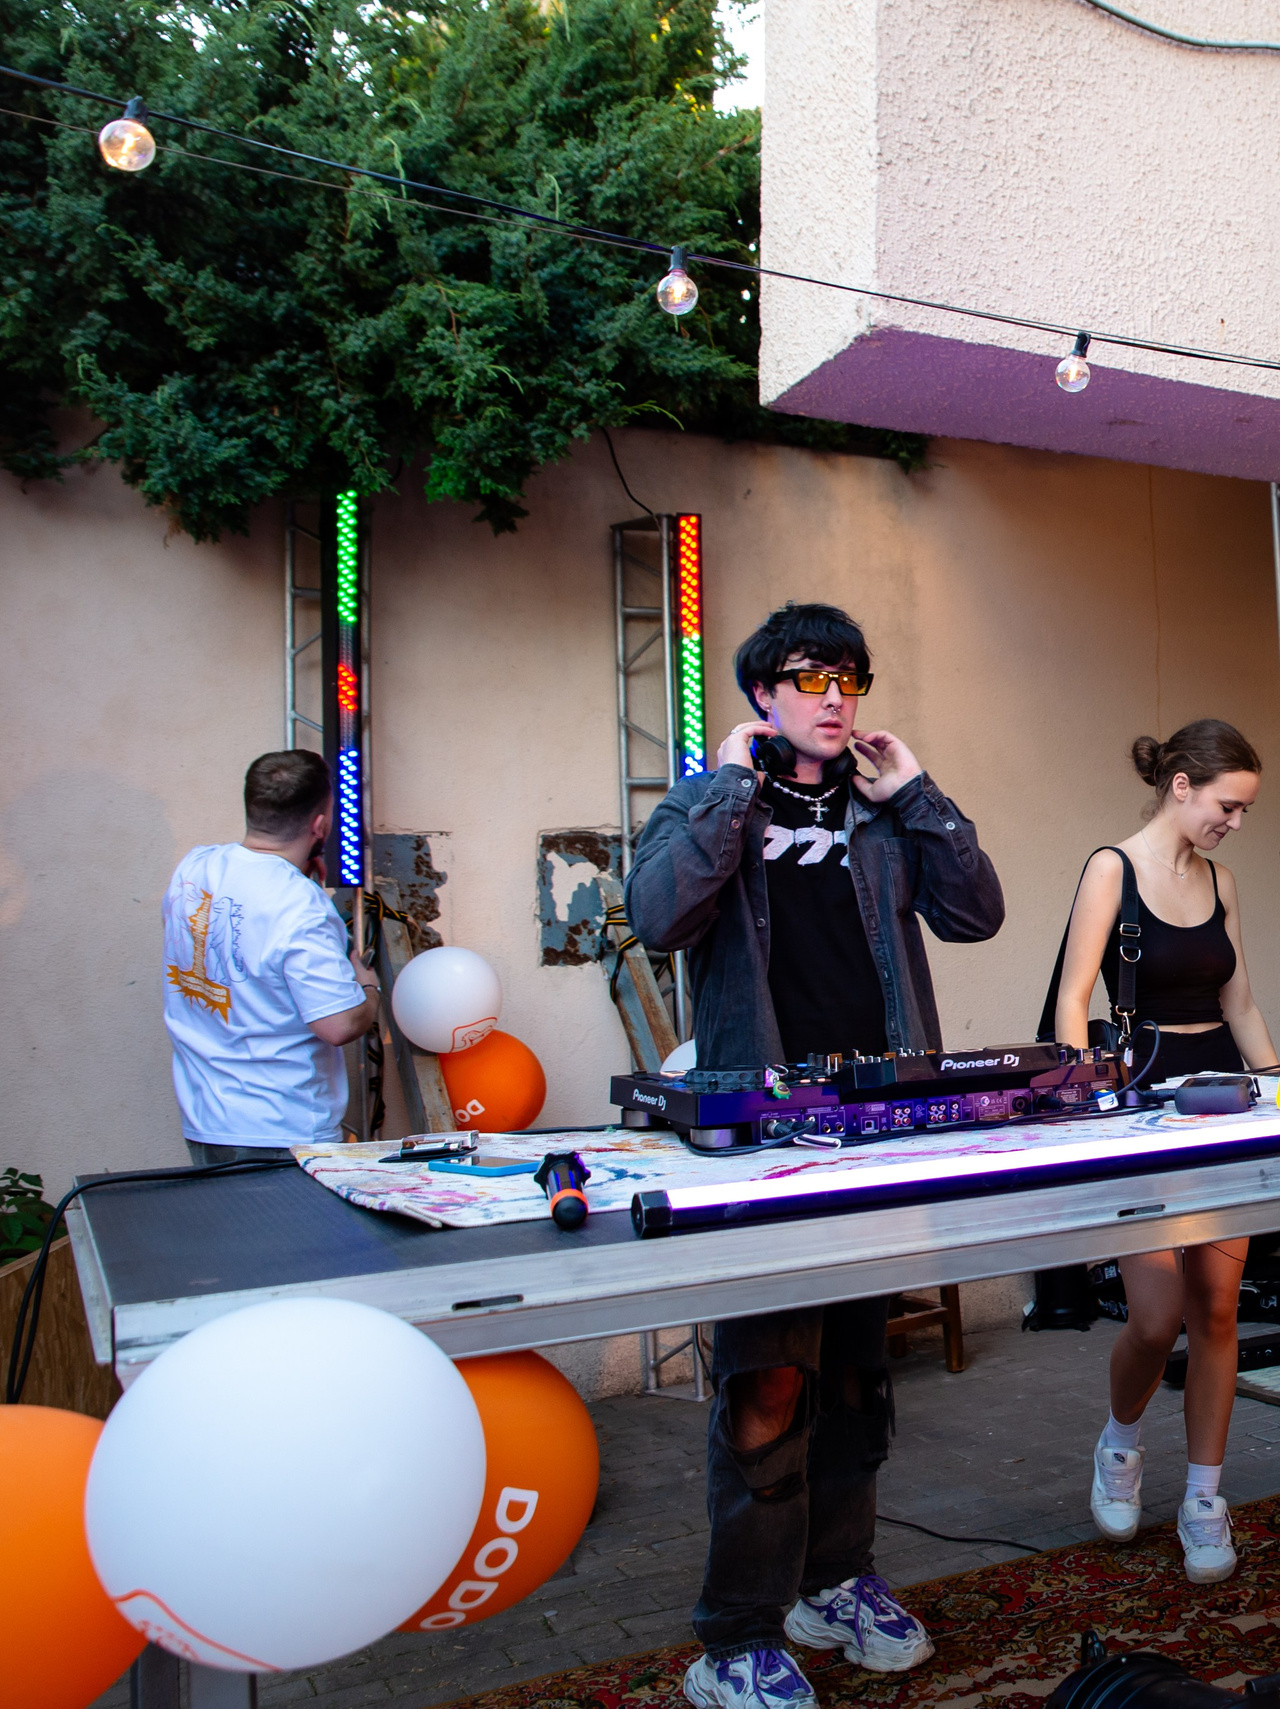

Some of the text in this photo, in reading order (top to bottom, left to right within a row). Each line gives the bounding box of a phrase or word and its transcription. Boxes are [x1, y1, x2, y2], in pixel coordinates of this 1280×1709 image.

[941, 1058, 1001, 1071] Pioneer
[632, 1088, 658, 1105] Pioneer
[454, 1098, 486, 1124] DO
[419, 1486, 539, 1632] DODO
